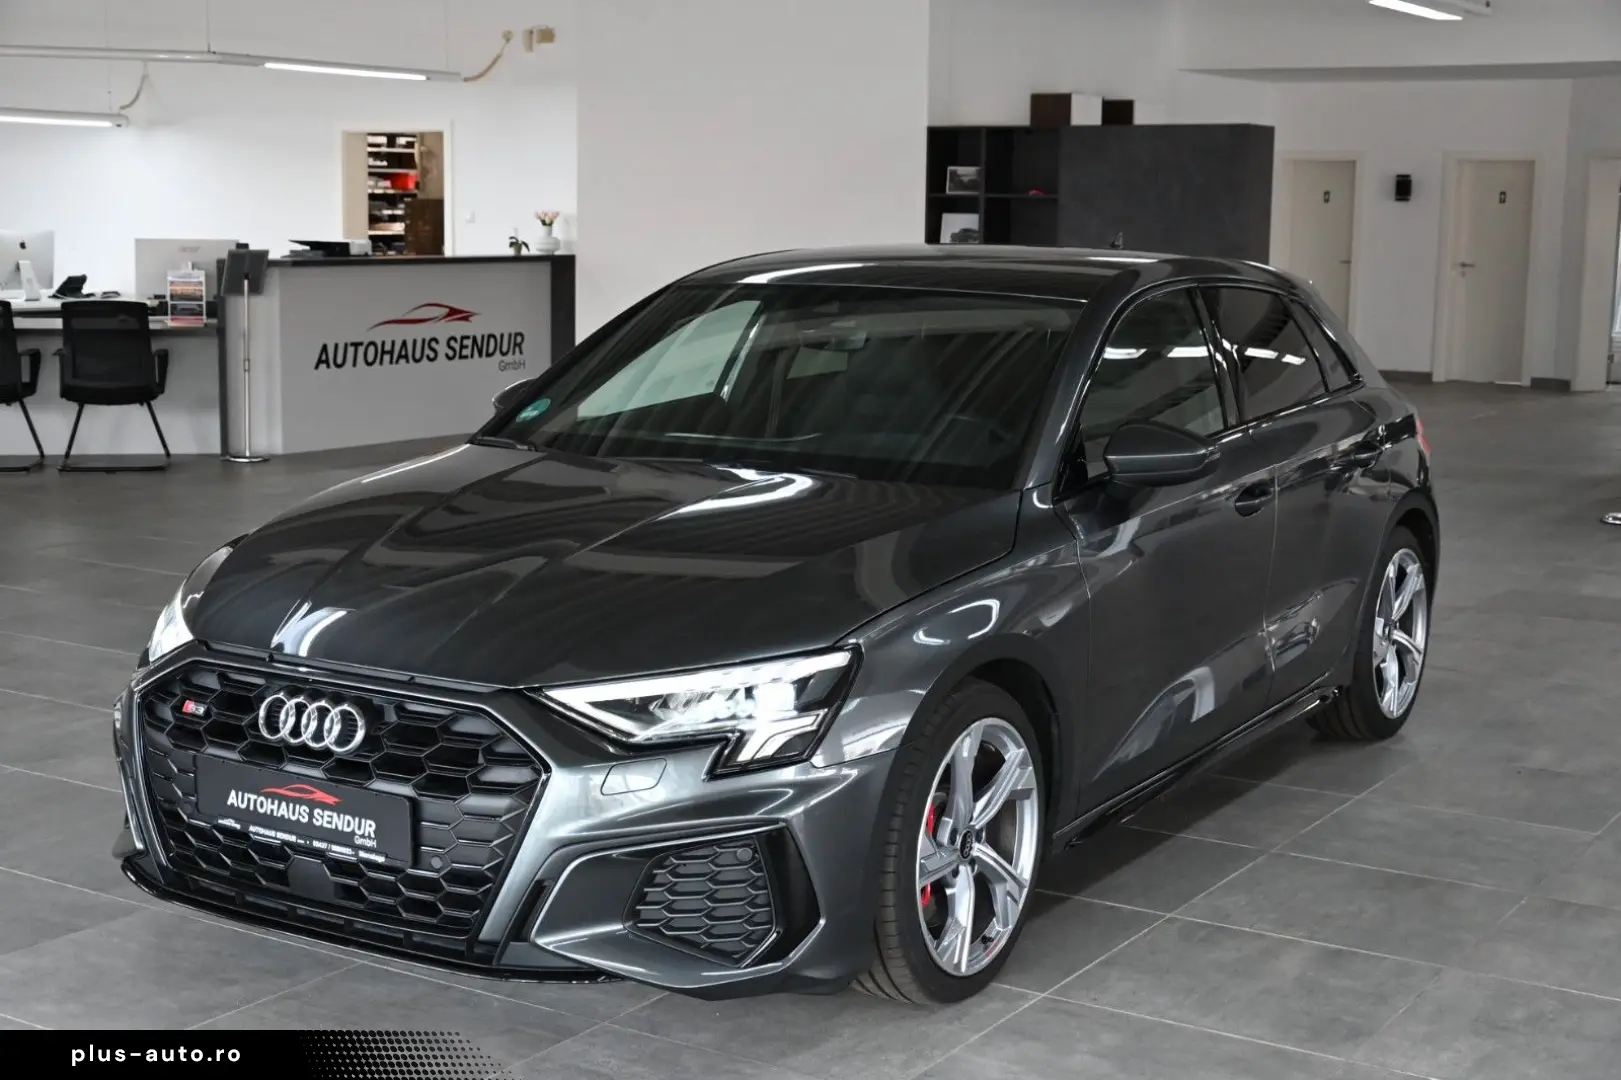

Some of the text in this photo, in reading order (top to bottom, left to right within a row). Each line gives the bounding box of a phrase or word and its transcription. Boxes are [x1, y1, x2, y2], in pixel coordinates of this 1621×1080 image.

[314, 331, 525, 371] AUTOHAUS SENDUR
[498, 360, 526, 372] GmbH
[226, 789, 376, 838] AUTOHAUS SENDUR
[354, 835, 377, 848] GmbH
